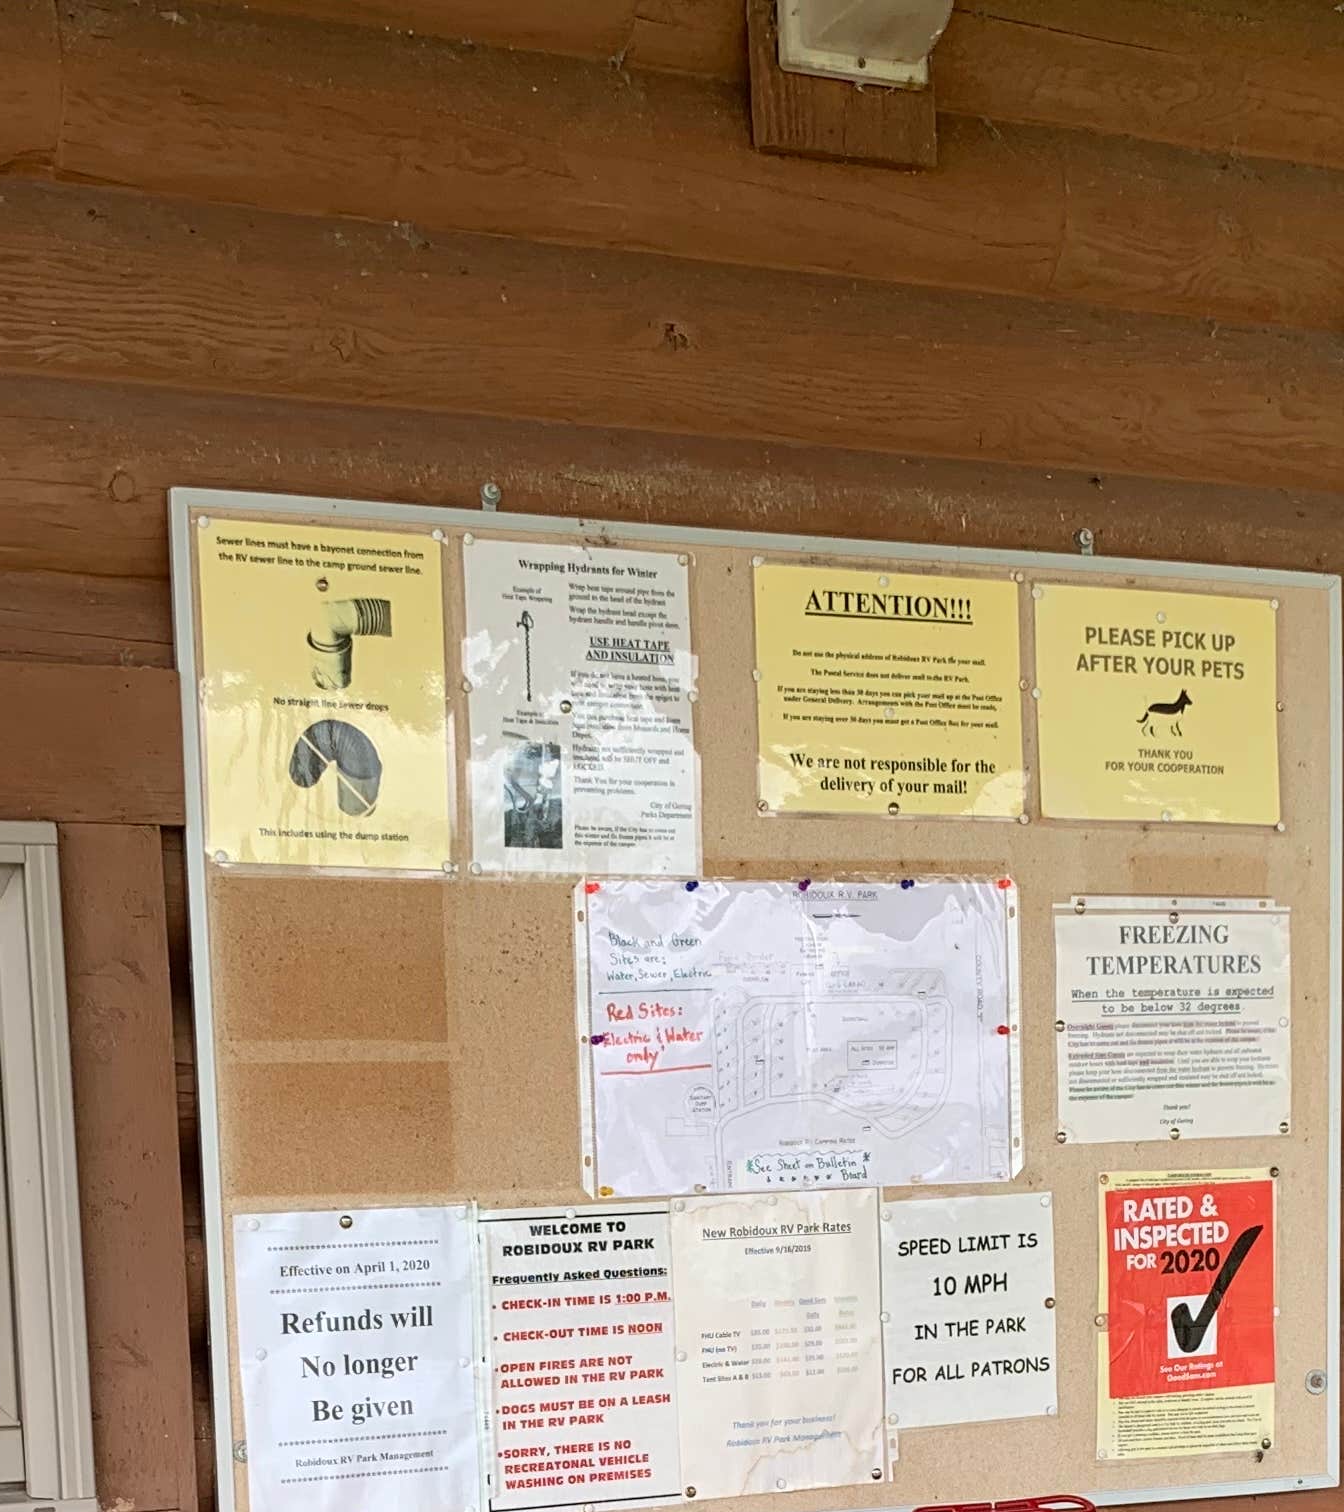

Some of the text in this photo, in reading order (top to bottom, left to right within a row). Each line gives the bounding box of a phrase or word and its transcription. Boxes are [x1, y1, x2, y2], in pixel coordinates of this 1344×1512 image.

[216, 536, 243, 546] Sewer
[245, 538, 265, 548] lines
[268, 541, 288, 549] must
[291, 540, 311, 551] have
[320, 543, 354, 555] bayonet
[357, 546, 402, 559] connection
[404, 549, 424, 560] from
[519, 559, 658, 579] Wrapping Hydrants for Winter
[805, 590, 972, 620] ATTENTION!!!
[590, 637, 670, 651] USE HEAT TAPE
[1085, 626, 1235, 652] PLEASE PICK UP
[586, 650, 675, 664] AND INSULATION
[1076, 653, 1244, 680] AFTER YOUR PETS
[790, 753, 995, 774] We are not responsible for the
[1138, 749, 1193, 760] THANK YOU
[1105, 761, 1224, 775] FOR YOUR COOPERATION
[821, 777, 967, 795] delivery of your mail!
[1120, 925, 1229, 944] FREEZING
[1087, 955, 1261, 975] TEMPERATURES
[1072, 986, 1274, 999] When the temperature is expected
[607, 1002, 682, 1022] Red Sites:
[627, 1047, 658, 1070] only
[1123, 1193, 1218, 1222] RATED &
[529, 1221, 626, 1236] WELCOME TO
[703, 1223, 851, 1238] New Robidoux RV Park Rates
[1114, 1221, 1229, 1250] INSPECTED
[503, 1239, 654, 1256] ROBIDOUX RV PARK
[898, 1233, 1038, 1256] SPEED LIMIT IS
[280, 1264, 333, 1277] Effective
[336, 1265, 350, 1274] on
[354, 1263, 385, 1275] April
[403, 1259, 430, 1271] 2020
[1126, 1248, 1219, 1274] FOR 2020
[492, 1267, 667, 1284] Frequently Asked Questions:
[933, 1273, 1007, 1296] 10 MPH
[280, 1306, 433, 1334] Refunds will
[915, 1317, 1026, 1340] IN THE PARK
[301, 1354, 417, 1379] No longer
[893, 1357, 1050, 1384] FOR ALL PATRONS
[312, 1397, 413, 1425] Be given
[505, 1454, 649, 1474] RECREATONAL VEHICLE
[506, 1469, 652, 1489] WASHING ON PREMISES
